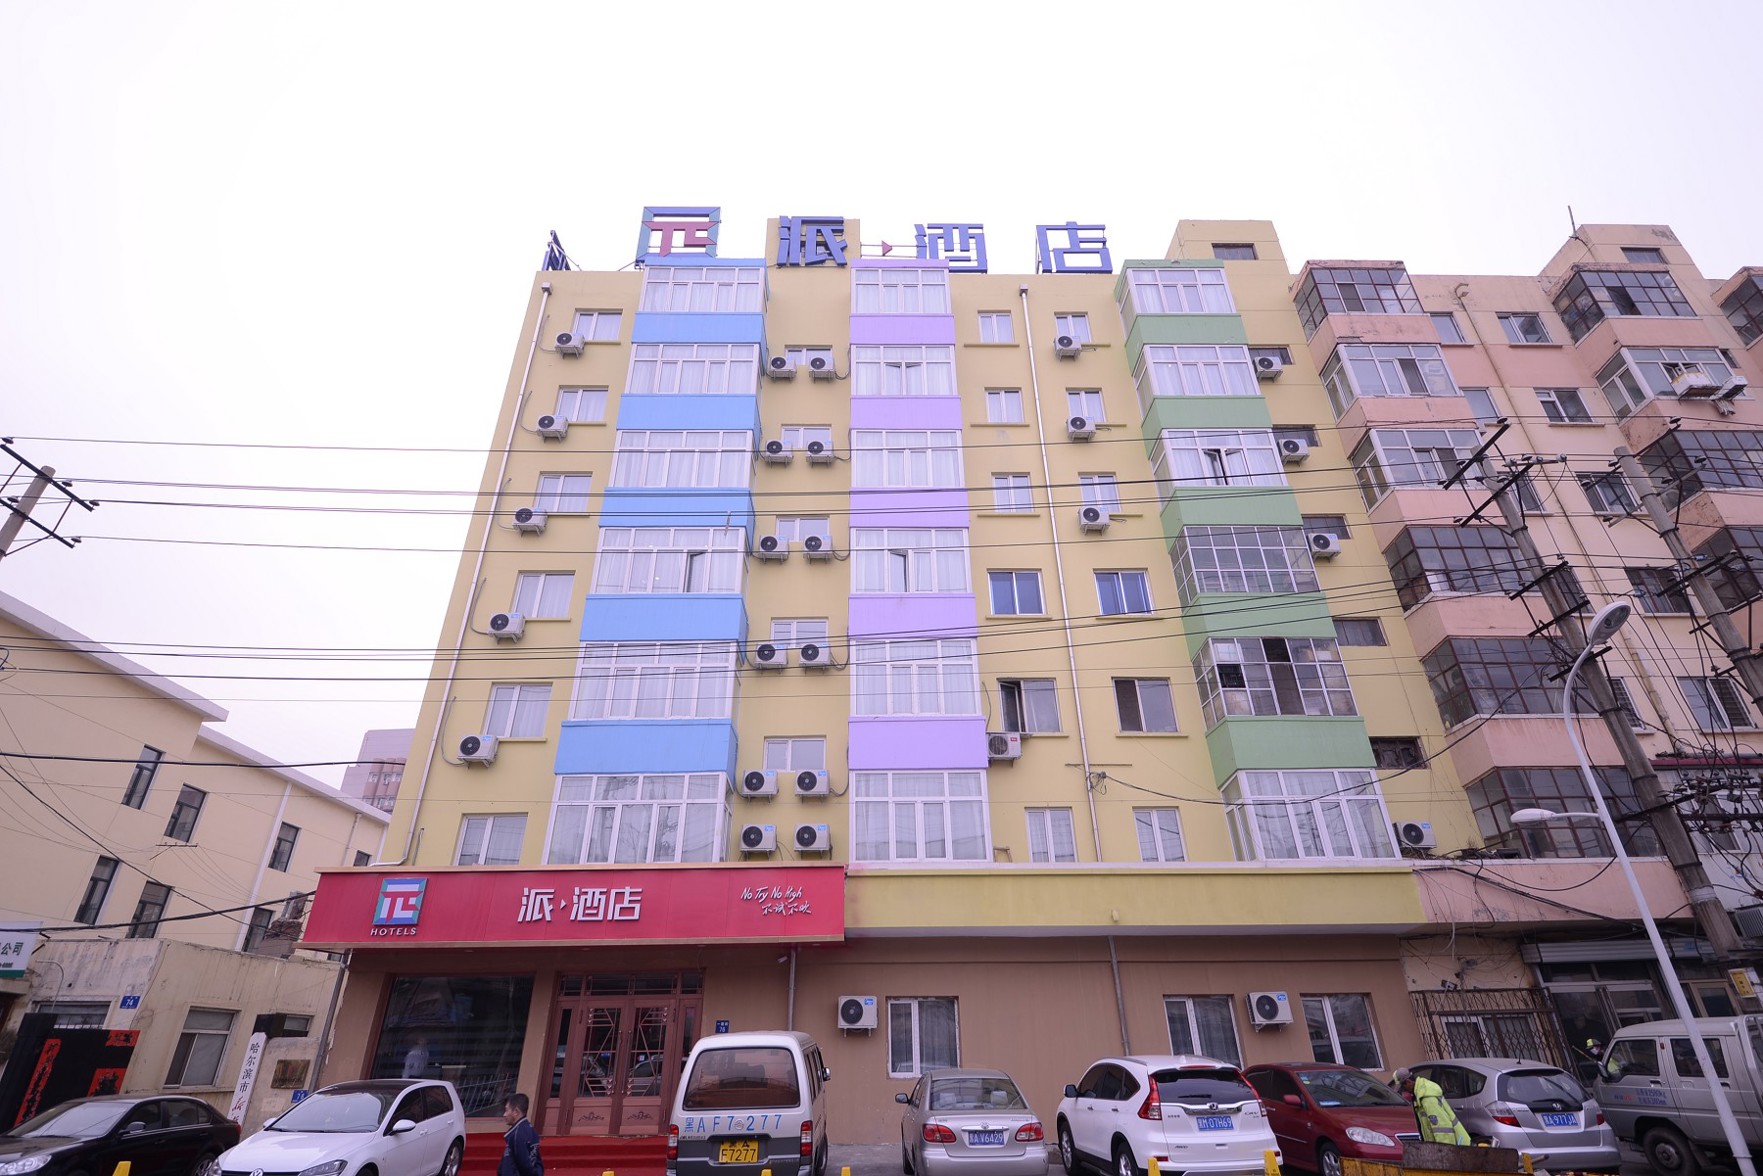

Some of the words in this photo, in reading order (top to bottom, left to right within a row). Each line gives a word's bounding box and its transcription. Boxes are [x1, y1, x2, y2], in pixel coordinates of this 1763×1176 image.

[741, 887, 752, 900] No
[755, 886, 768, 903] Try
[771, 886, 782, 899] No
[785, 886, 802, 902] High
[370, 927, 417, 936] HOTELS
[720, 1149, 756, 1161] F7277
